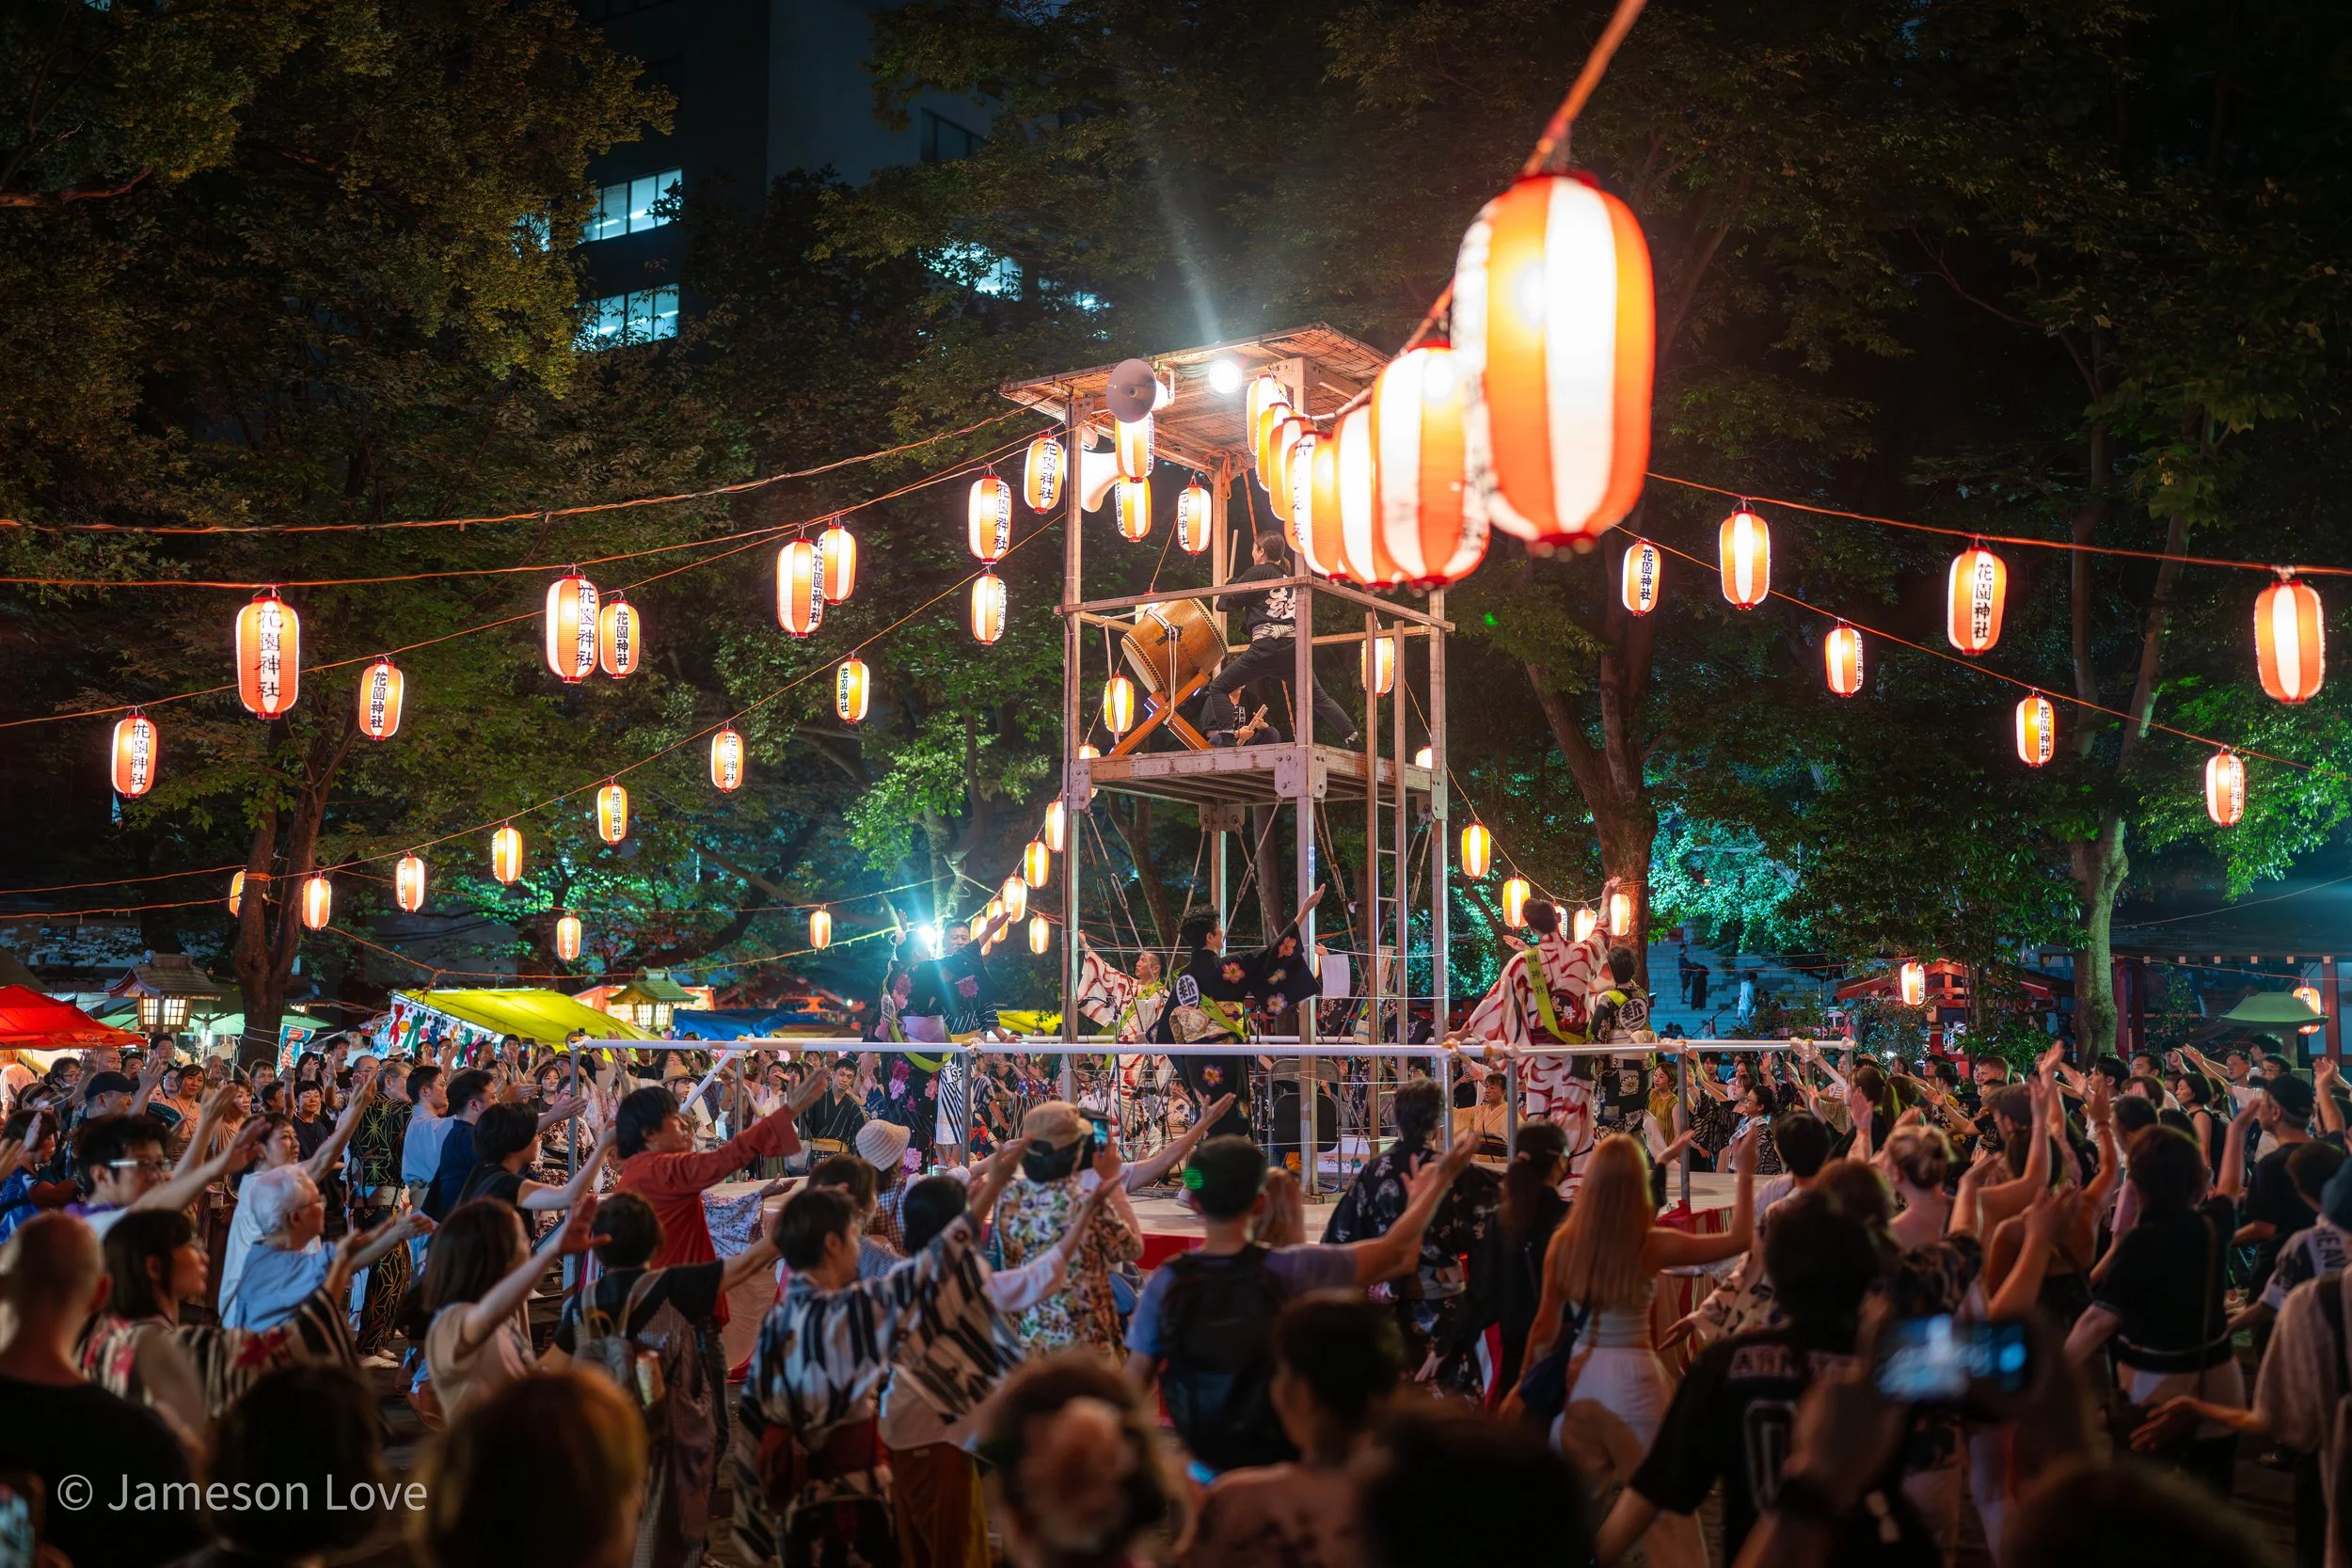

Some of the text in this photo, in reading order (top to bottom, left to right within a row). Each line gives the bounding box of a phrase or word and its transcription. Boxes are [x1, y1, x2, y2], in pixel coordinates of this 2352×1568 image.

[1040, 440, 1058, 500] 花園神社
[993, 483, 1009, 549] 花園神社
[810, 554, 823, 624] 花園神社
[1640, 548, 1654, 600] 花園神社
[1975, 563, 1993, 639] 花園神社
[255, 608, 284, 699] 花園神社
[576, 585, 596, 667] 花園神社
[615, 610, 629, 666] 花園神社
[370, 672, 388, 729] 花園神社
[839, 668, 850, 712] 花園神社
[129, 723, 151, 786] 花園神社
[2040, 706, 2050, 756] 花園神社
[612, 792, 622, 835] 花園神社
